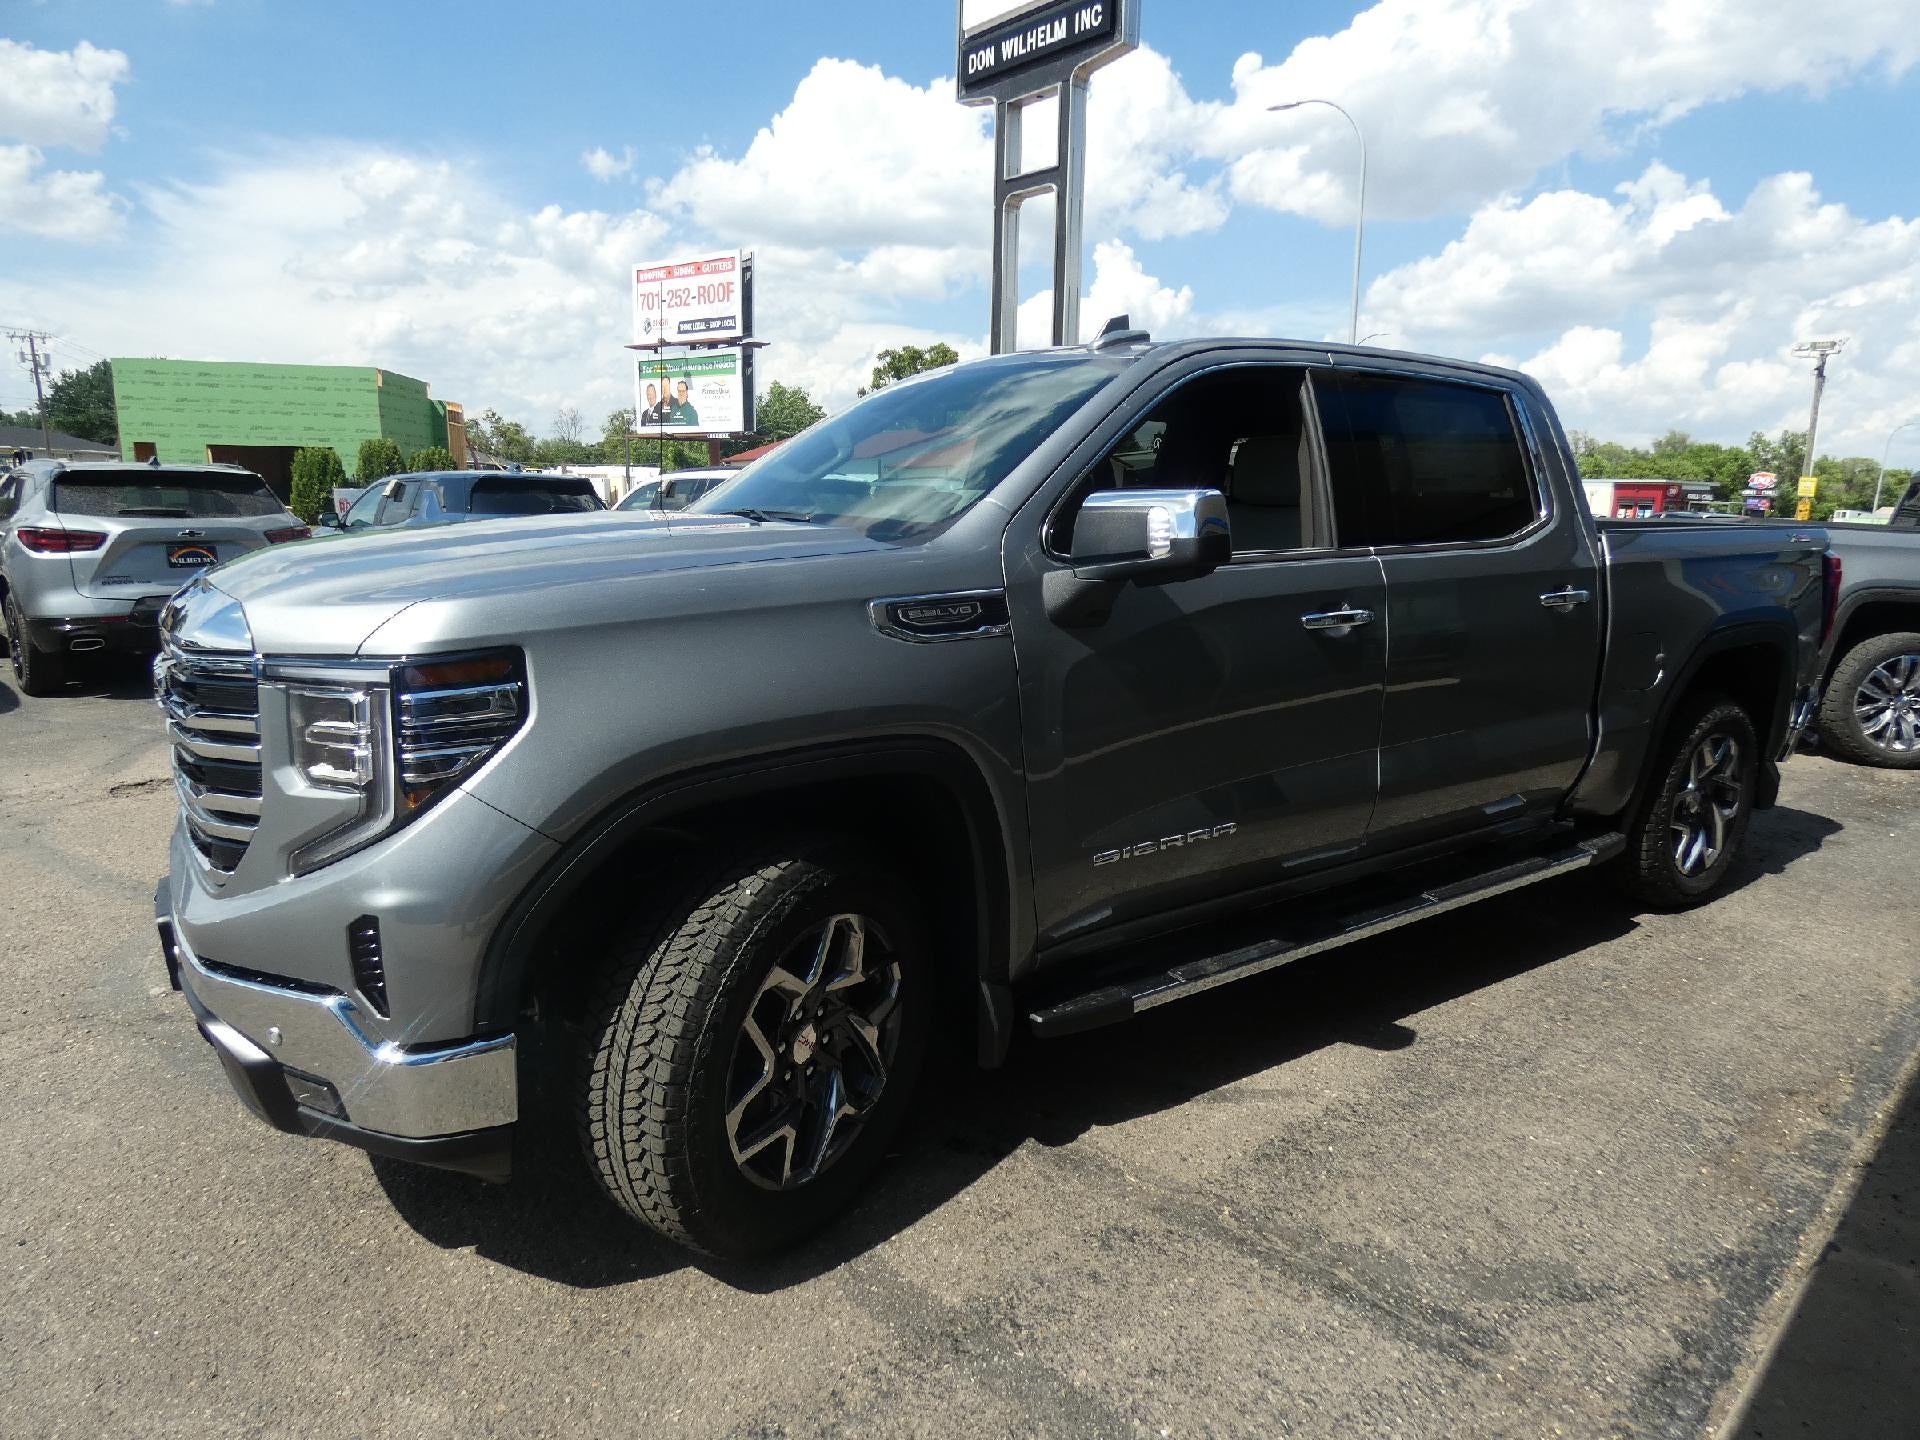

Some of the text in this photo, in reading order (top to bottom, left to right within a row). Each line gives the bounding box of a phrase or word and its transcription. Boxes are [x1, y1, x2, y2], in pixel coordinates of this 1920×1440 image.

[968, 4, 1103, 75] DON WILHELM INC
[702, 261, 733, 273] GUTTERS
[639, 281, 735, 311] 701-252-ROOF
[693, 321, 706, 331] LOCAL
[722, 318, 735, 328] LOCAL
[642, 365, 653, 374] For
[667, 363, 680, 372] Your
[681, 361, 713, 371] Insurance
[713, 360, 735, 370] Needs
[1093, 822, 1238, 867] SIERRA
